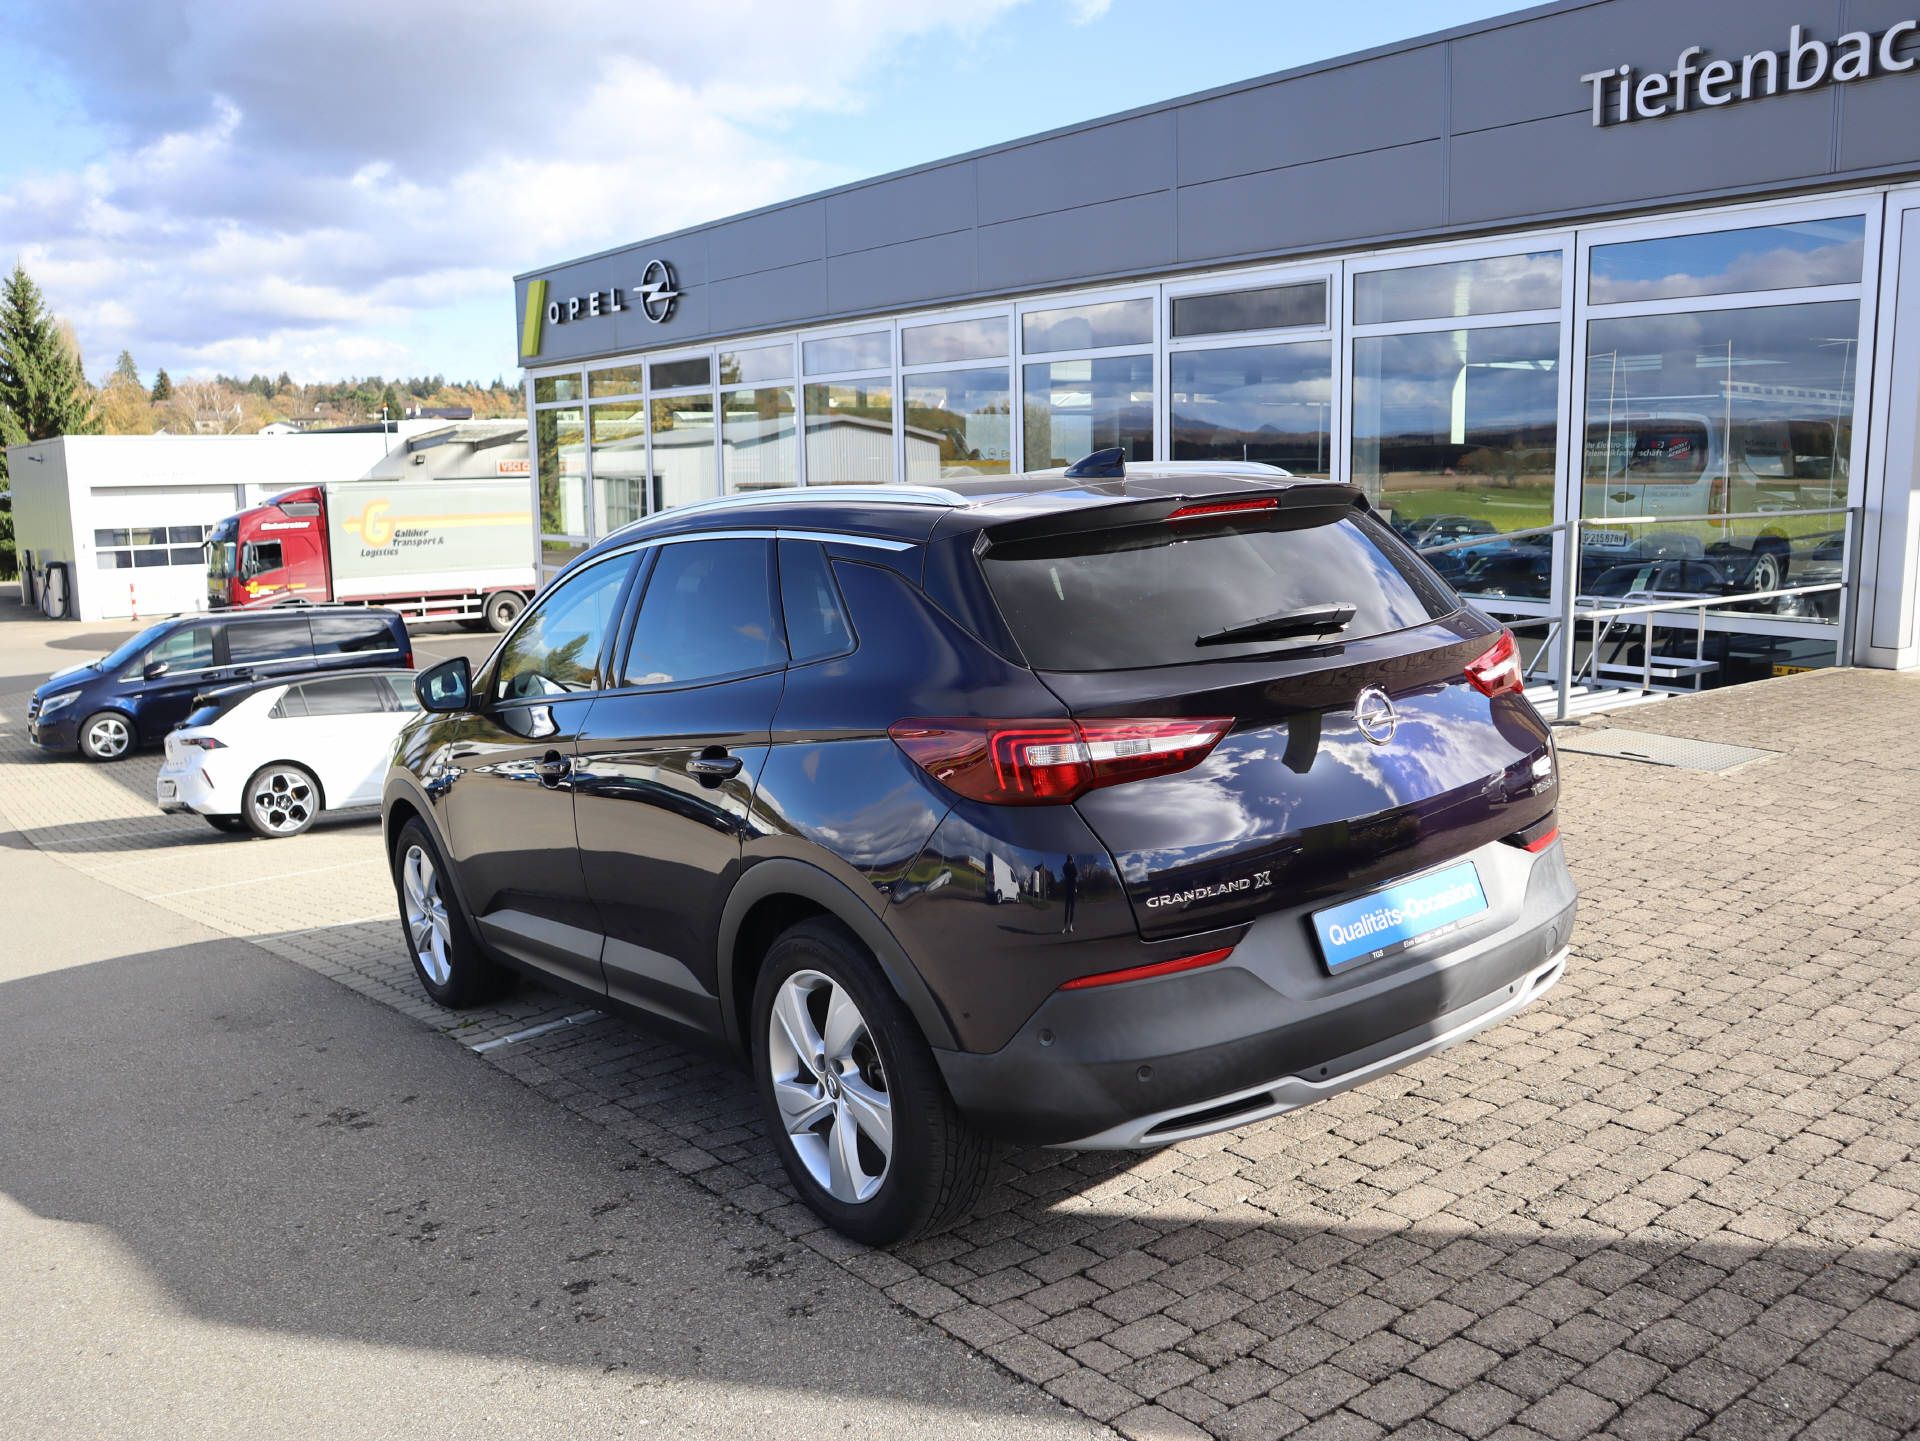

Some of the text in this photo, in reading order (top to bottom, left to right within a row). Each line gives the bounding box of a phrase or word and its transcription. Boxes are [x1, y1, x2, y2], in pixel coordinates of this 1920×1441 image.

[1580, 20, 1917, 127] Tiefenbac
[548, 287, 621, 325] OPEL
[392, 537, 436, 547] Transport
[394, 528, 429, 538] Galliker
[360, 548, 399, 558] Logistics
[1146, 870, 1272, 908] GRANDLAND X
[1329, 882, 1477, 946] Qualitäts-Occasion
